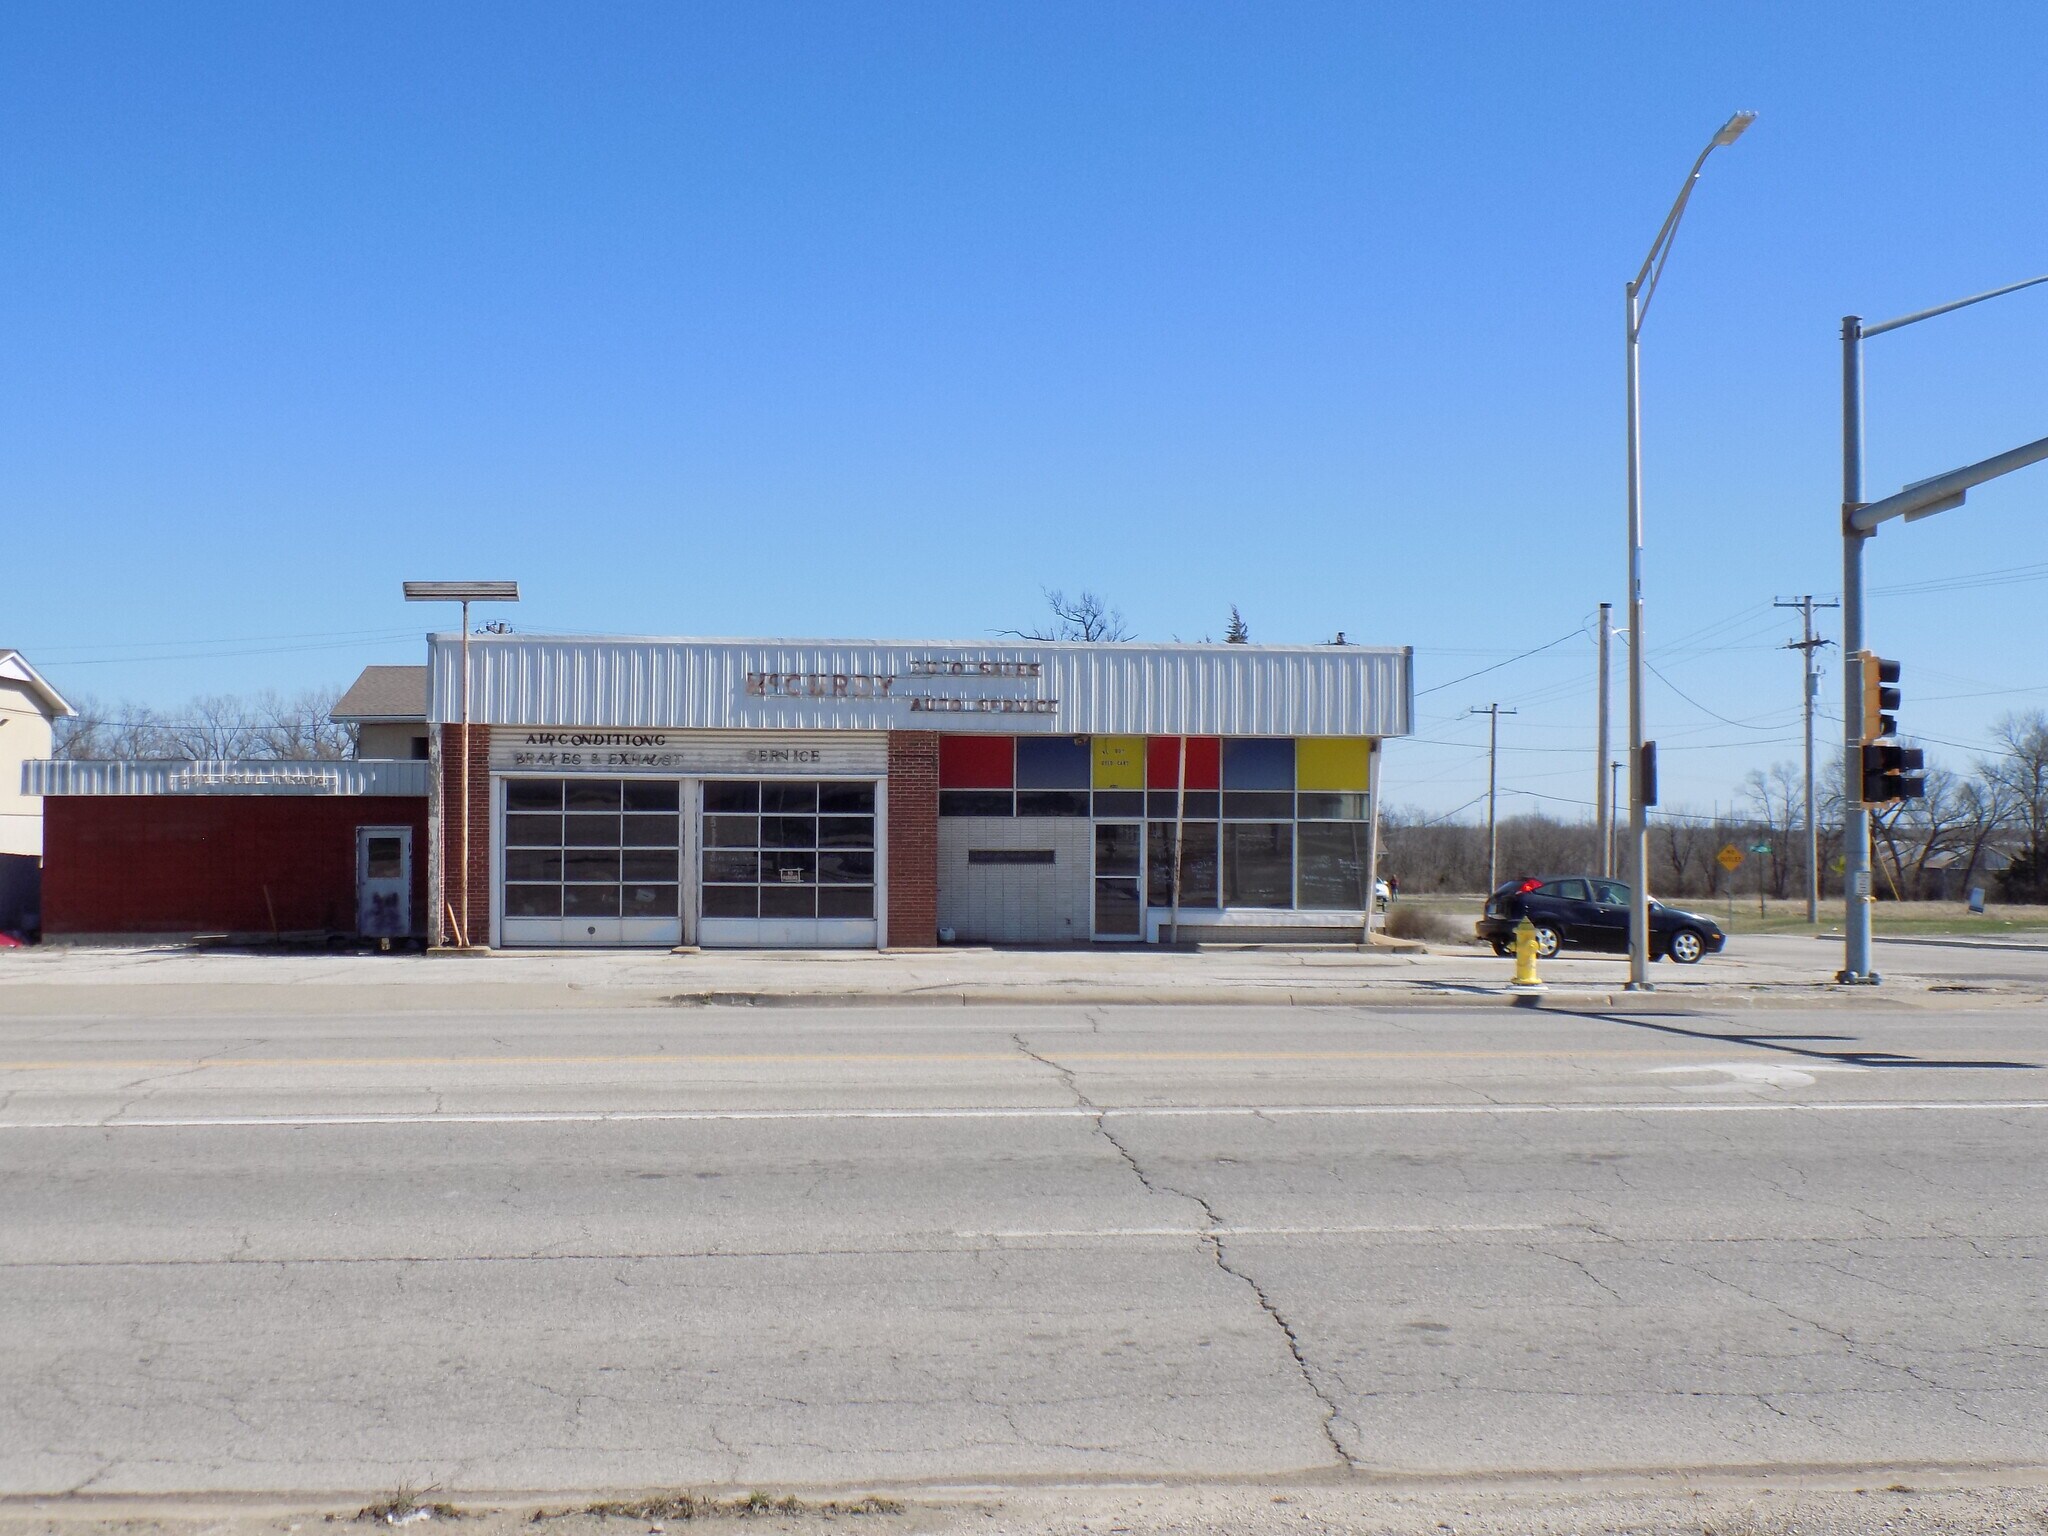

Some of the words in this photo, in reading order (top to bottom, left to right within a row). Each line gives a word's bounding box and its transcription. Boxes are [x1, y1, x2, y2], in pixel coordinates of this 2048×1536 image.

[911, 698, 961, 711] AUTO
[978, 699, 1058, 713] SERVICE
[514, 752, 581, 765] BRAKES
[746, 750, 821, 763] SERVICE
